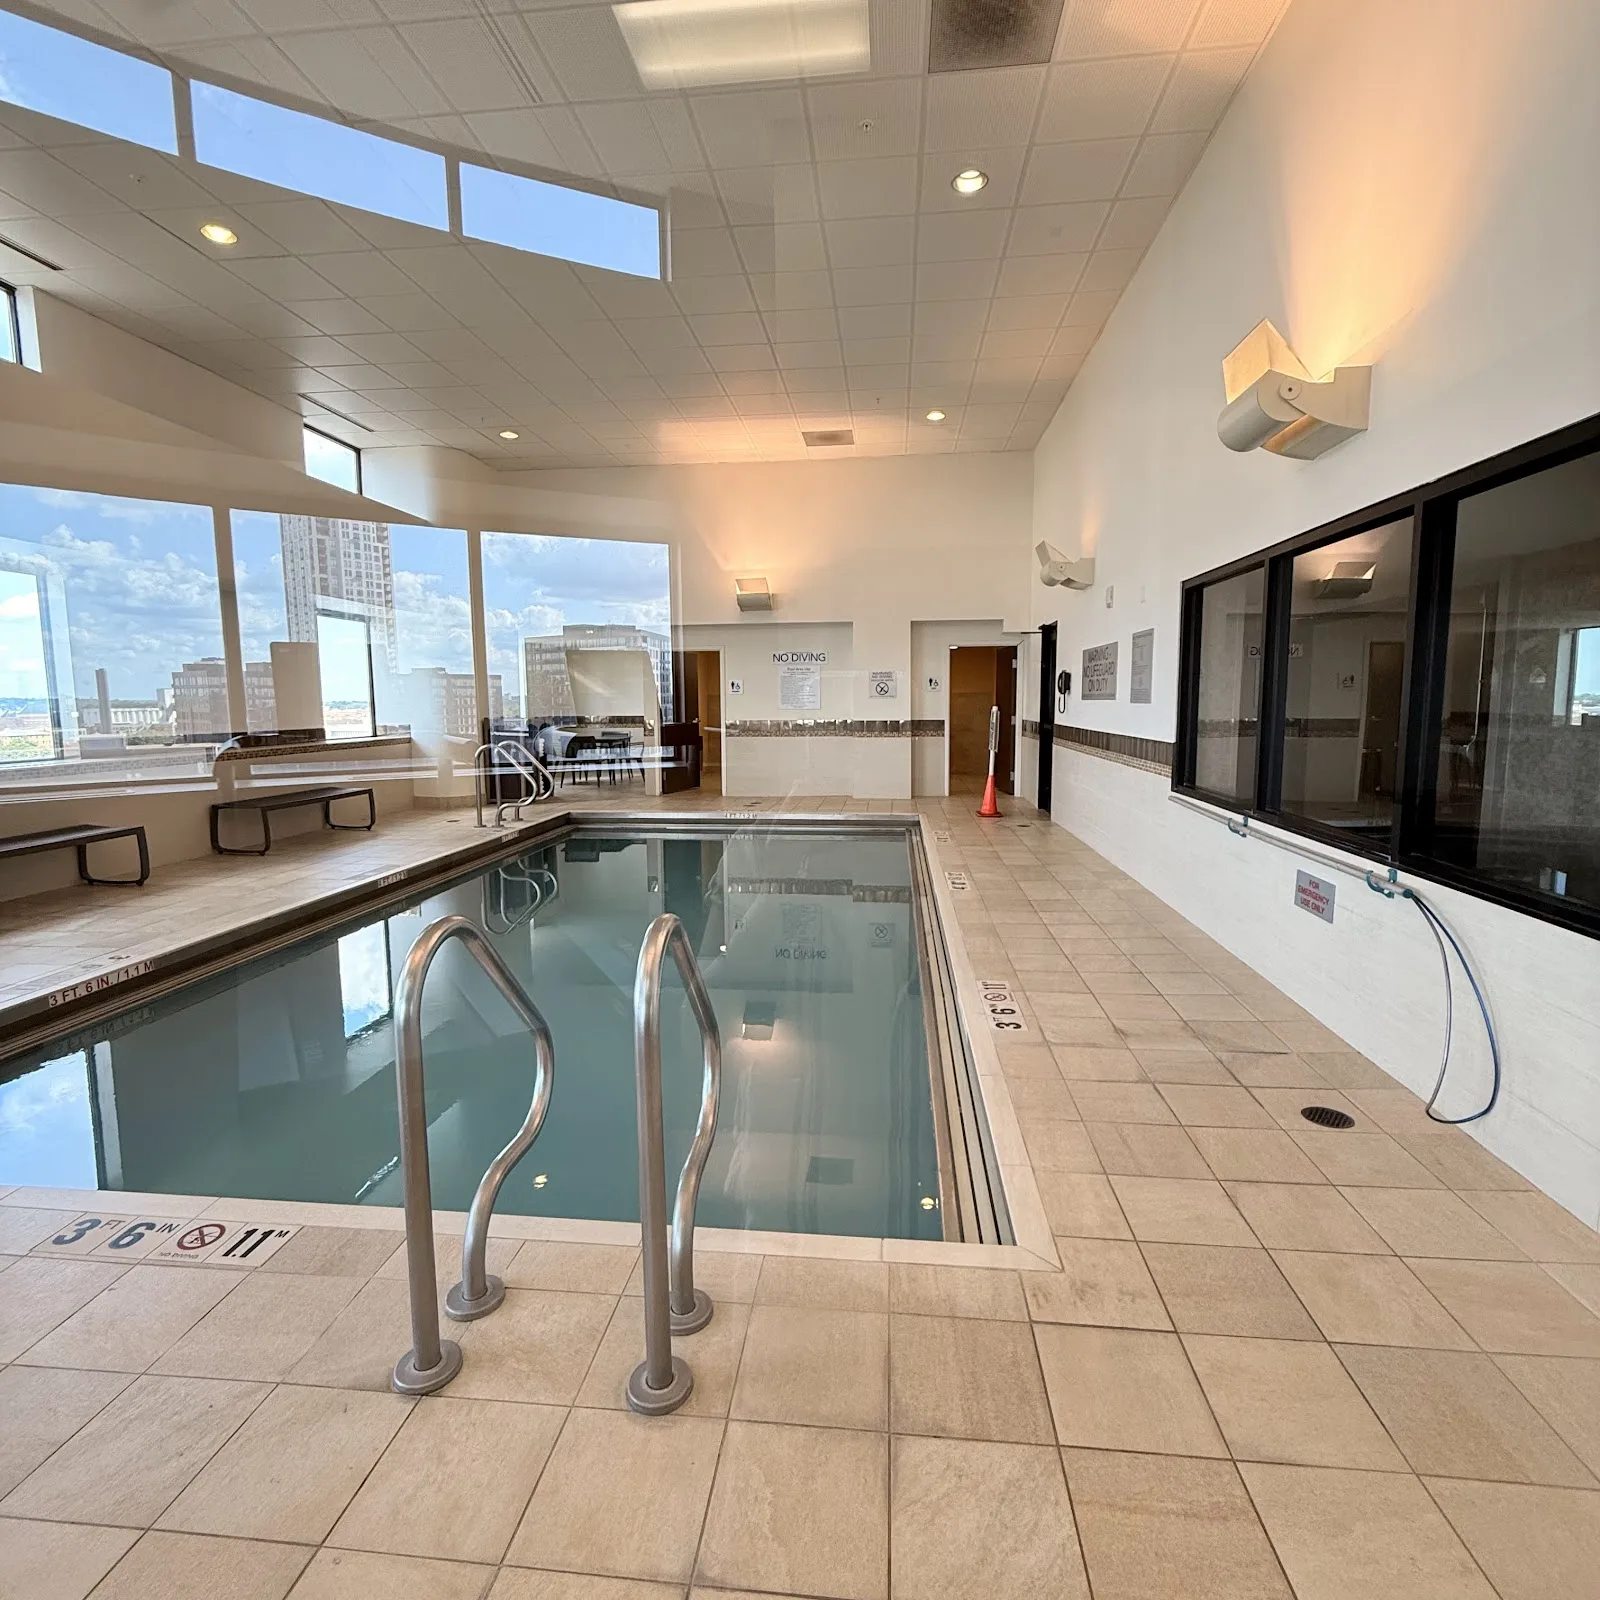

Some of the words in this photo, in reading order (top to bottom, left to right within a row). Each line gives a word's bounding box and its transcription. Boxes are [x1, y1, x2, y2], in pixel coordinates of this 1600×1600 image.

[773, 653, 789, 662] NO
[791, 653, 826, 662] DIVING
[1083, 664, 1090, 678] NO
[1309, 879, 1320, 890] FOR
[1298, 885, 1329, 905] EMERGENCY
[1301, 896, 1311, 908] USE
[1311, 902, 1325, 914] ONLY
[49, 994, 58, 1007] 3
[85, 982, 93, 993] 6
[124, 965, 140, 979] 1.1
[144, 960, 154, 972] M
[101, 1219, 126, 1230] FT
[155, 1223, 181, 1234] IN
[52, 1218, 102, 1246] 3
[108, 1222, 156, 1249] 6
[274, 1230, 290, 1239] M
